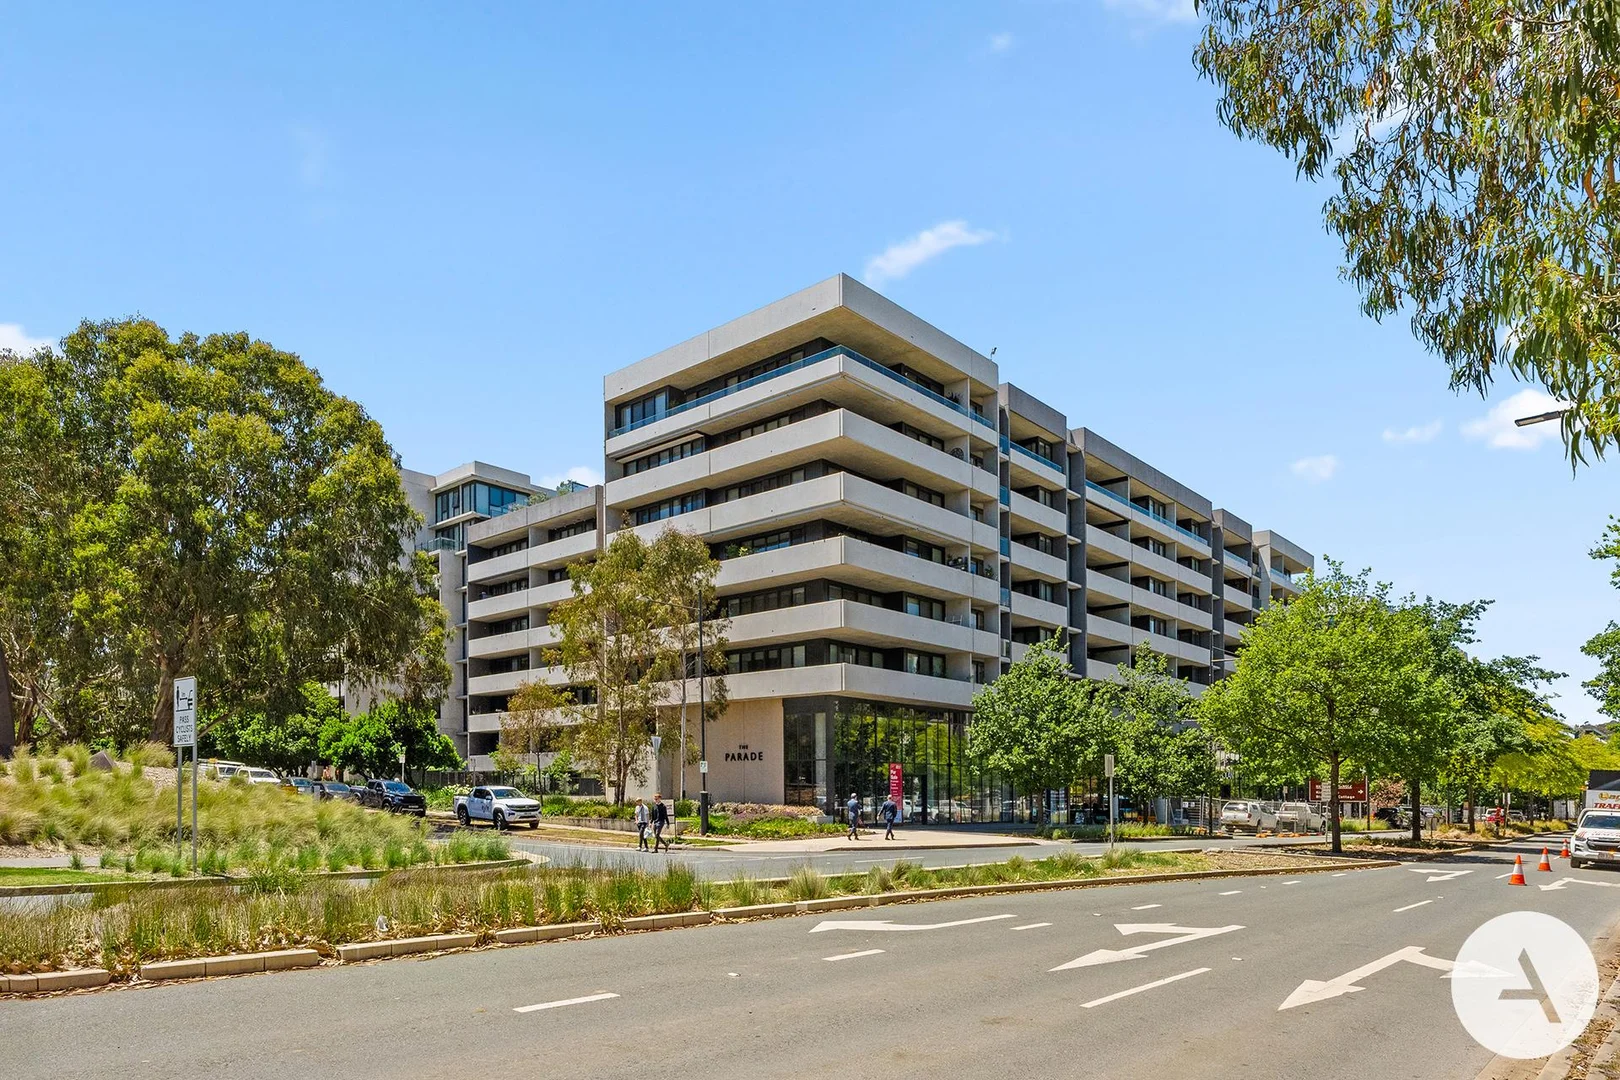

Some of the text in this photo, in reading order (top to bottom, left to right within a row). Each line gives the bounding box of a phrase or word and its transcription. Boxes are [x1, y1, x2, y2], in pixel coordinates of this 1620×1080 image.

[179, 715, 189, 723] PASS
[175, 725, 193, 734] CYCLISTS
[177, 734, 191, 743] SAFELY
[725, 751, 764, 762] PARADE
